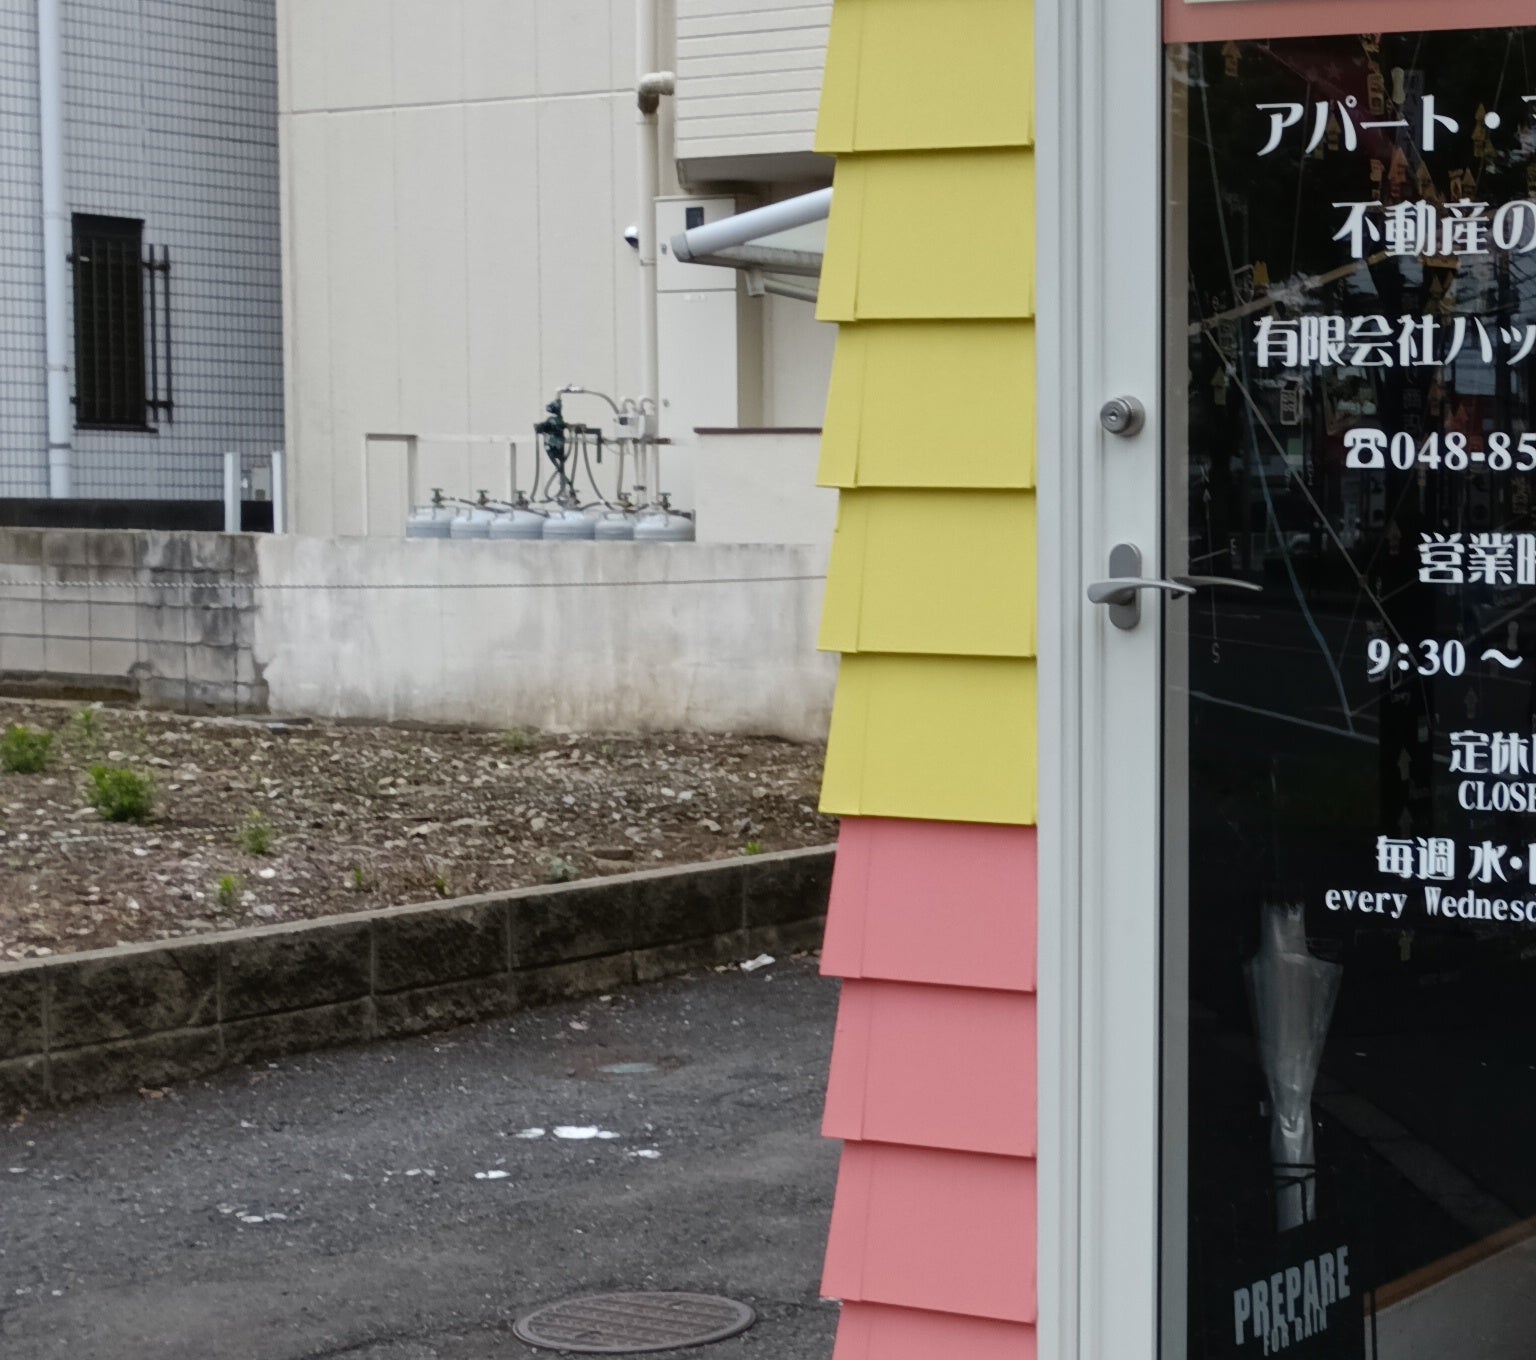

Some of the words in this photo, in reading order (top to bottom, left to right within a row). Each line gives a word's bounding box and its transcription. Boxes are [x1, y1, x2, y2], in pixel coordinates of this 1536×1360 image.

[1367, 638, 1466, 677] 9:30
[1376, 835, 1455, 881] 毎週
[1325, 886, 1408, 917] every
[1234, 1244, 1350, 1345] PREPARE
